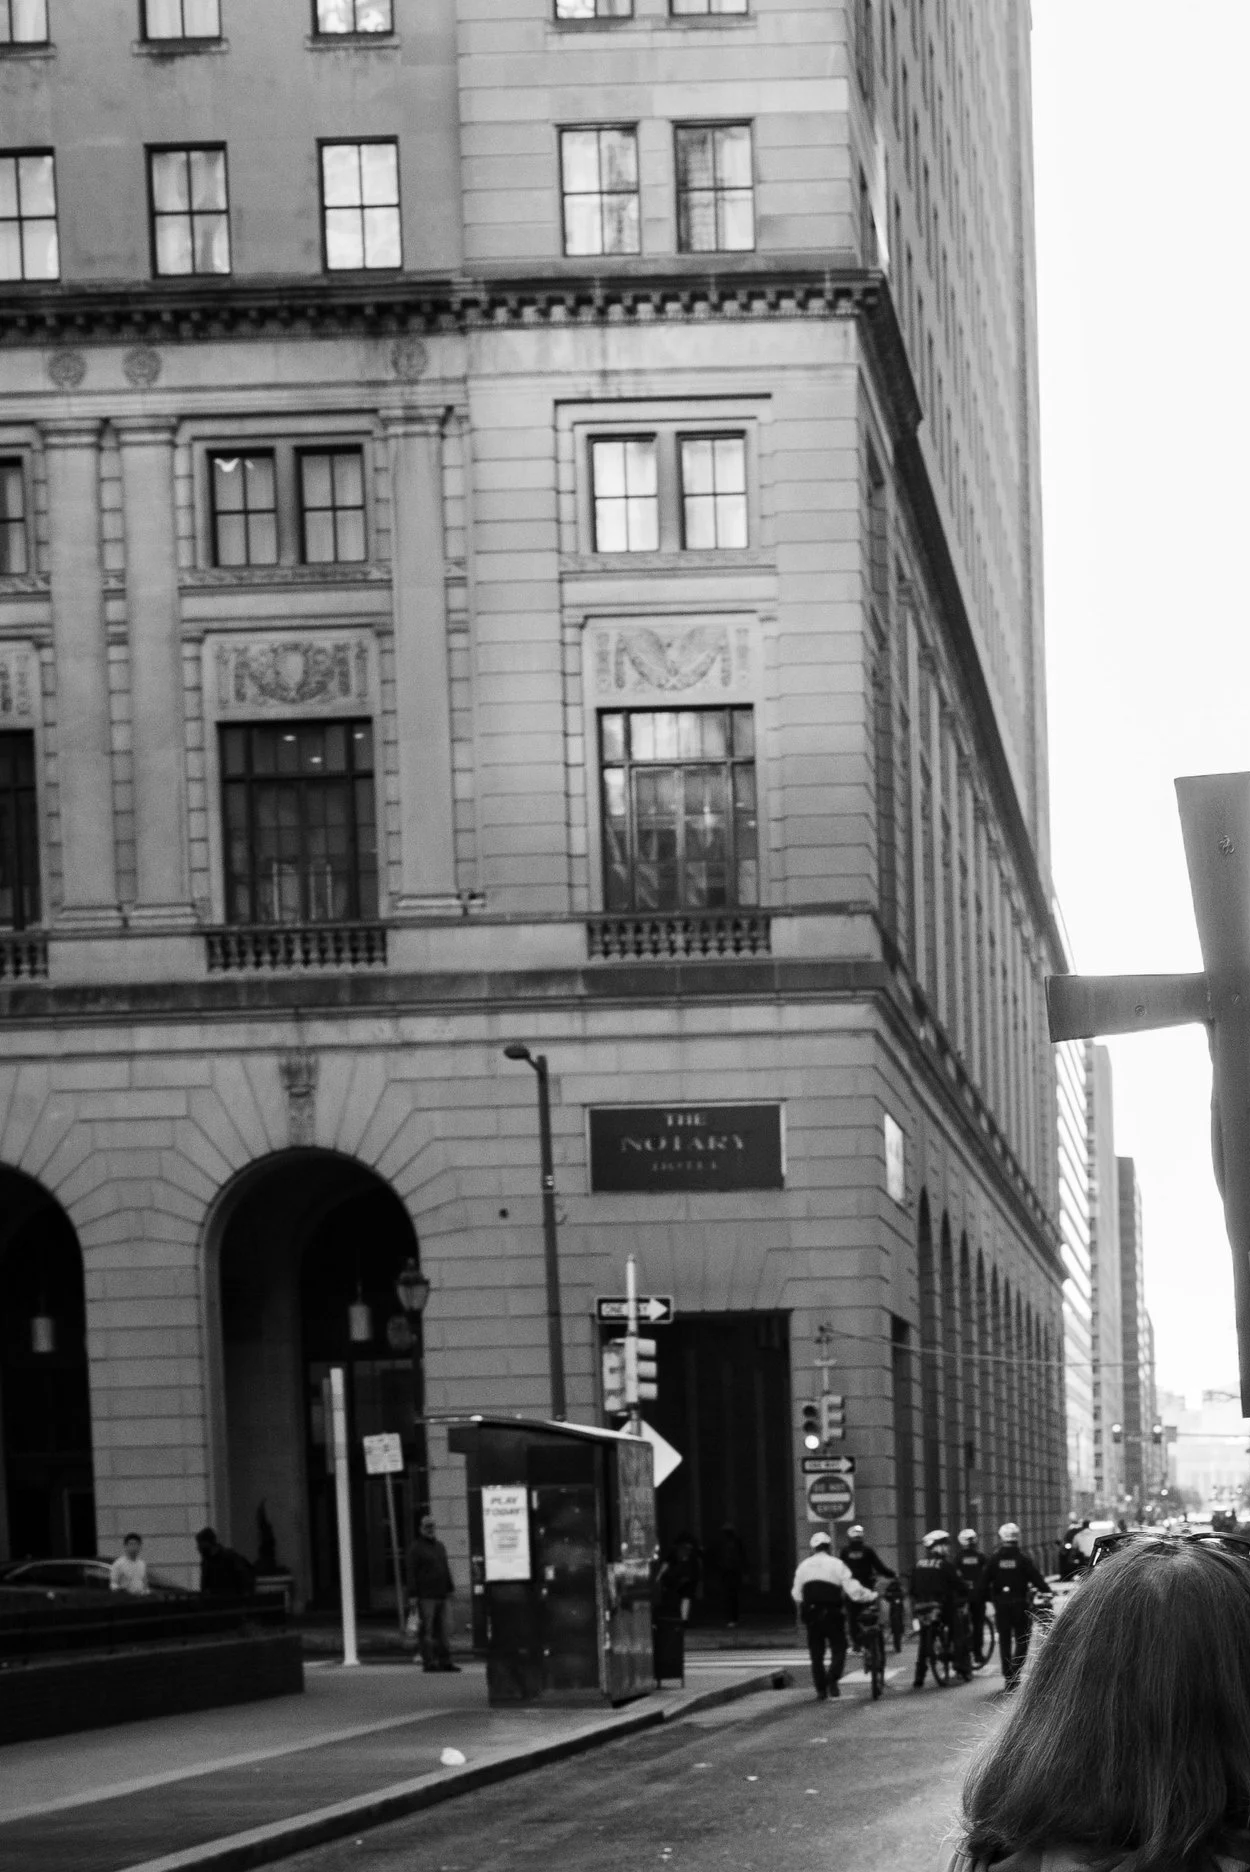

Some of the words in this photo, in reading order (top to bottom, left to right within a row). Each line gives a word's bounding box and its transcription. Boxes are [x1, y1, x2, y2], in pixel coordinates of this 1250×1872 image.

[665, 1113, 706, 1127] THE
[621, 1133, 745, 1152] NOTARY
[490, 1497, 518, 1505] PLAY
